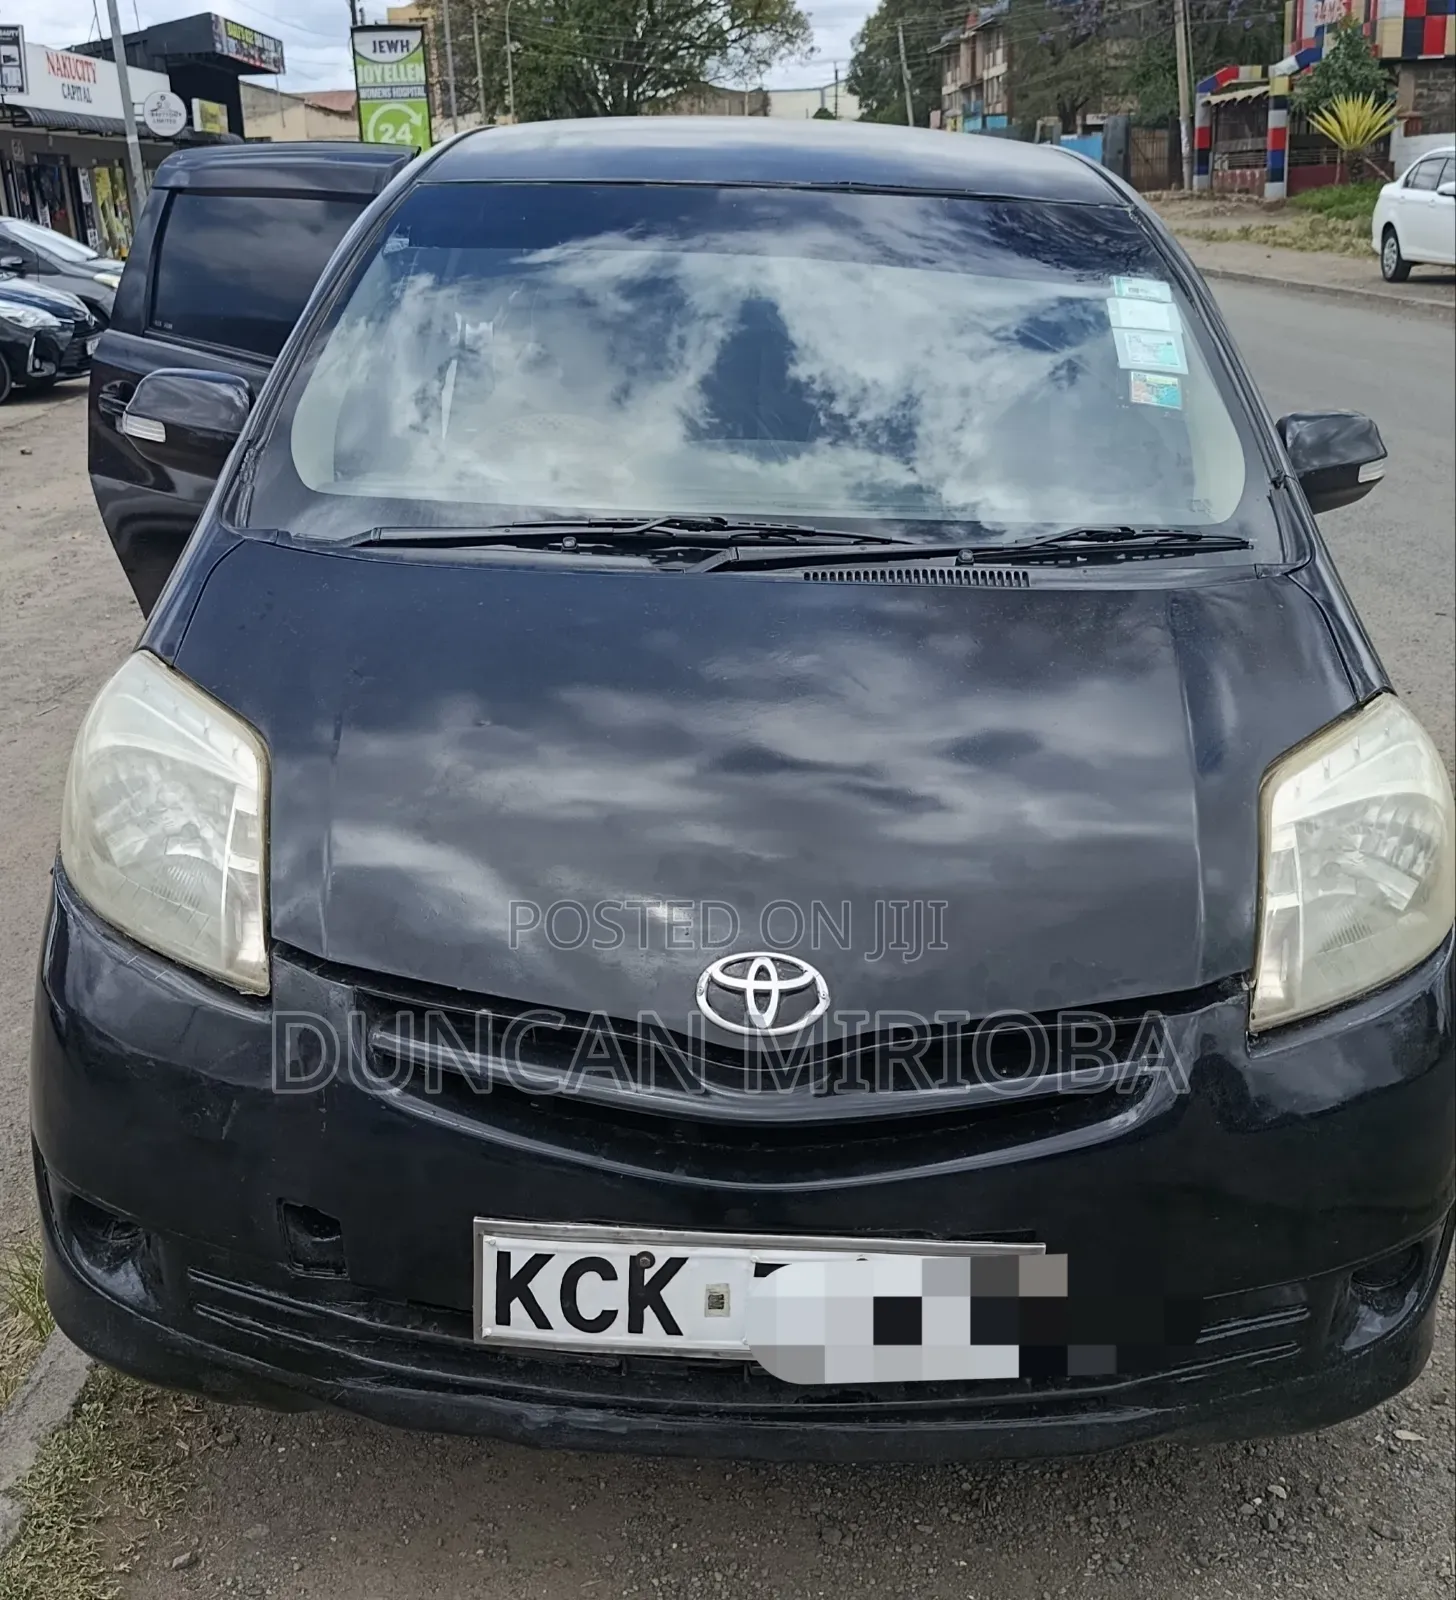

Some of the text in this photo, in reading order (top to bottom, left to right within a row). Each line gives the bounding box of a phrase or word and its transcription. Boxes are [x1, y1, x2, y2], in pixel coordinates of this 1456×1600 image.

[45, 51, 97, 84] NAKUCITY
[61, 83, 92, 104] CAPITAL
[379, 122, 413, 144] 24
[496, 1250, 689, 1336] KCK
